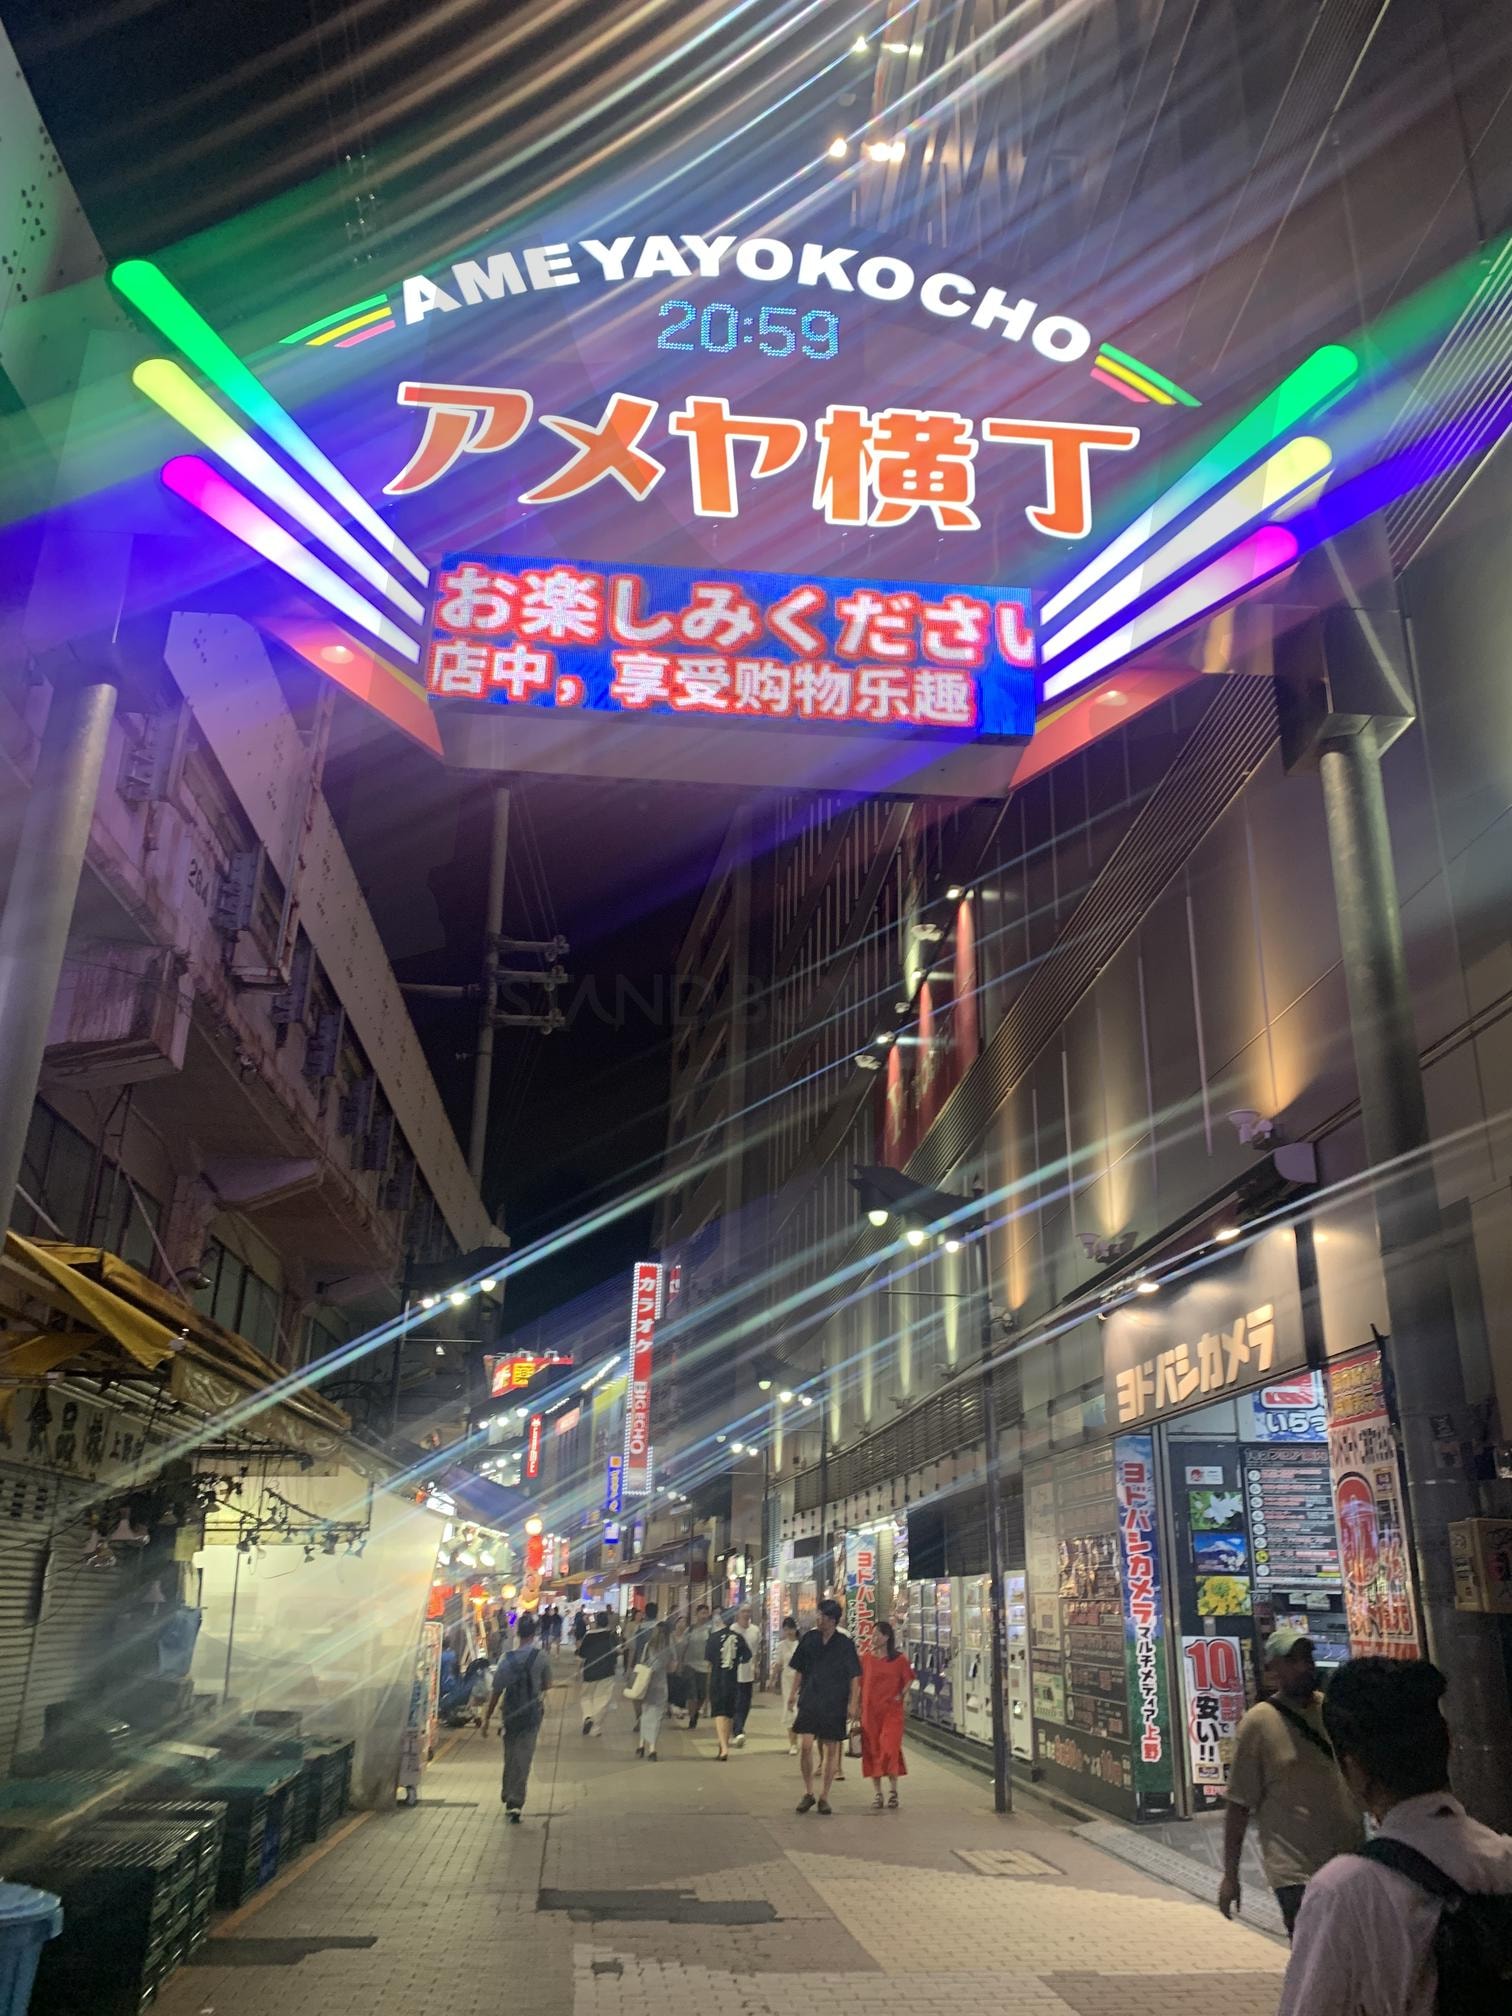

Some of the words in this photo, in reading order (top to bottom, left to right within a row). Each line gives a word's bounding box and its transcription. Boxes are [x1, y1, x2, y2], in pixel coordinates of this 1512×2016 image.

[402, 235, 1091, 362] AMEYAYOKOCHO
[657, 300, 841, 360] 20:59
[383, 381, 1140, 540] アメヤ横丁
[637, 1277, 657, 1354] カラオケ
[1115, 1303, 1275, 1424] ヨドバシカメラ
[630, 1411, 647, 1454] ECHO
[633, 1381, 649, 1409] BIG
[1123, 1461, 1154, 1626] ヨドバシカメラ
